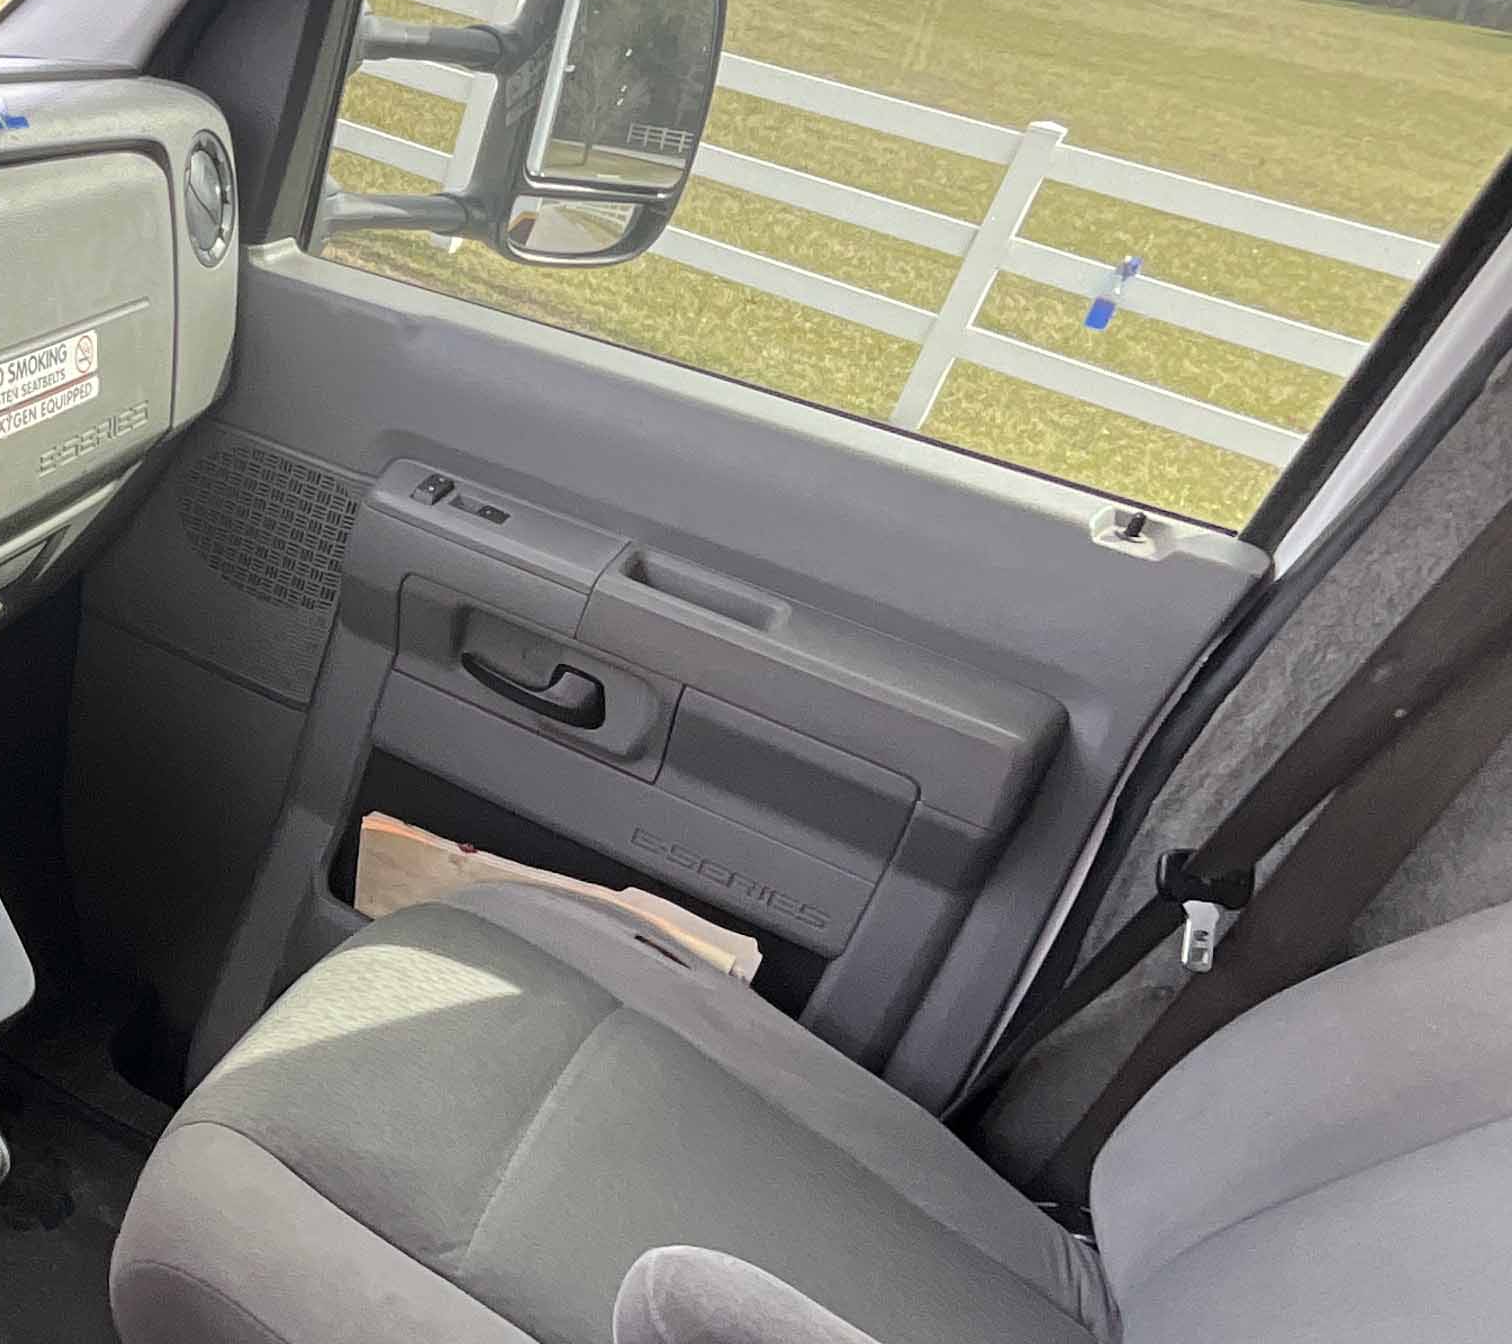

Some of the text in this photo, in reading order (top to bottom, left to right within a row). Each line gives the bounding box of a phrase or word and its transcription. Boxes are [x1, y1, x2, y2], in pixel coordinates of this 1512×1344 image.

[7, 343, 68, 383] SMOKING
[20, 368, 67, 397] SEATBELTS
[40, 382, 93, 418] EQUIPPED
